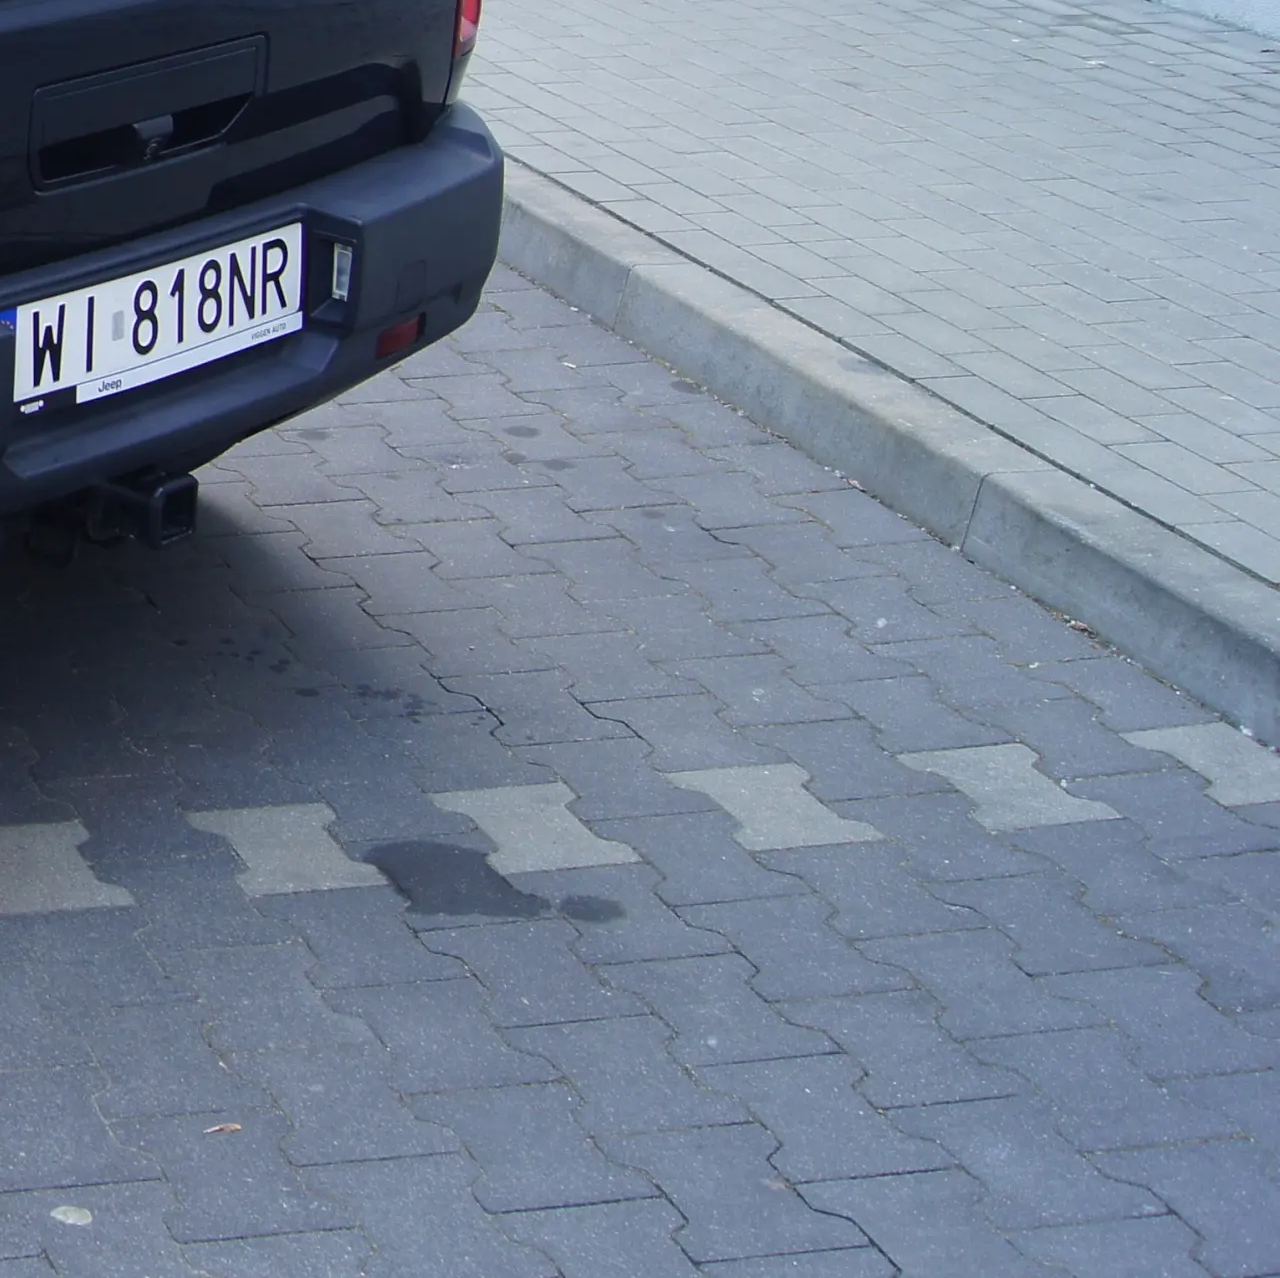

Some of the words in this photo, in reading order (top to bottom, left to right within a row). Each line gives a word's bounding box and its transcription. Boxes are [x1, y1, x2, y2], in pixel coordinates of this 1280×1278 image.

[32, 294, 95, 388] WI
[132, 237, 288, 356] 818NR
[272, 322, 287, 333] AUTO
[97, 378, 122, 393] Jeep
